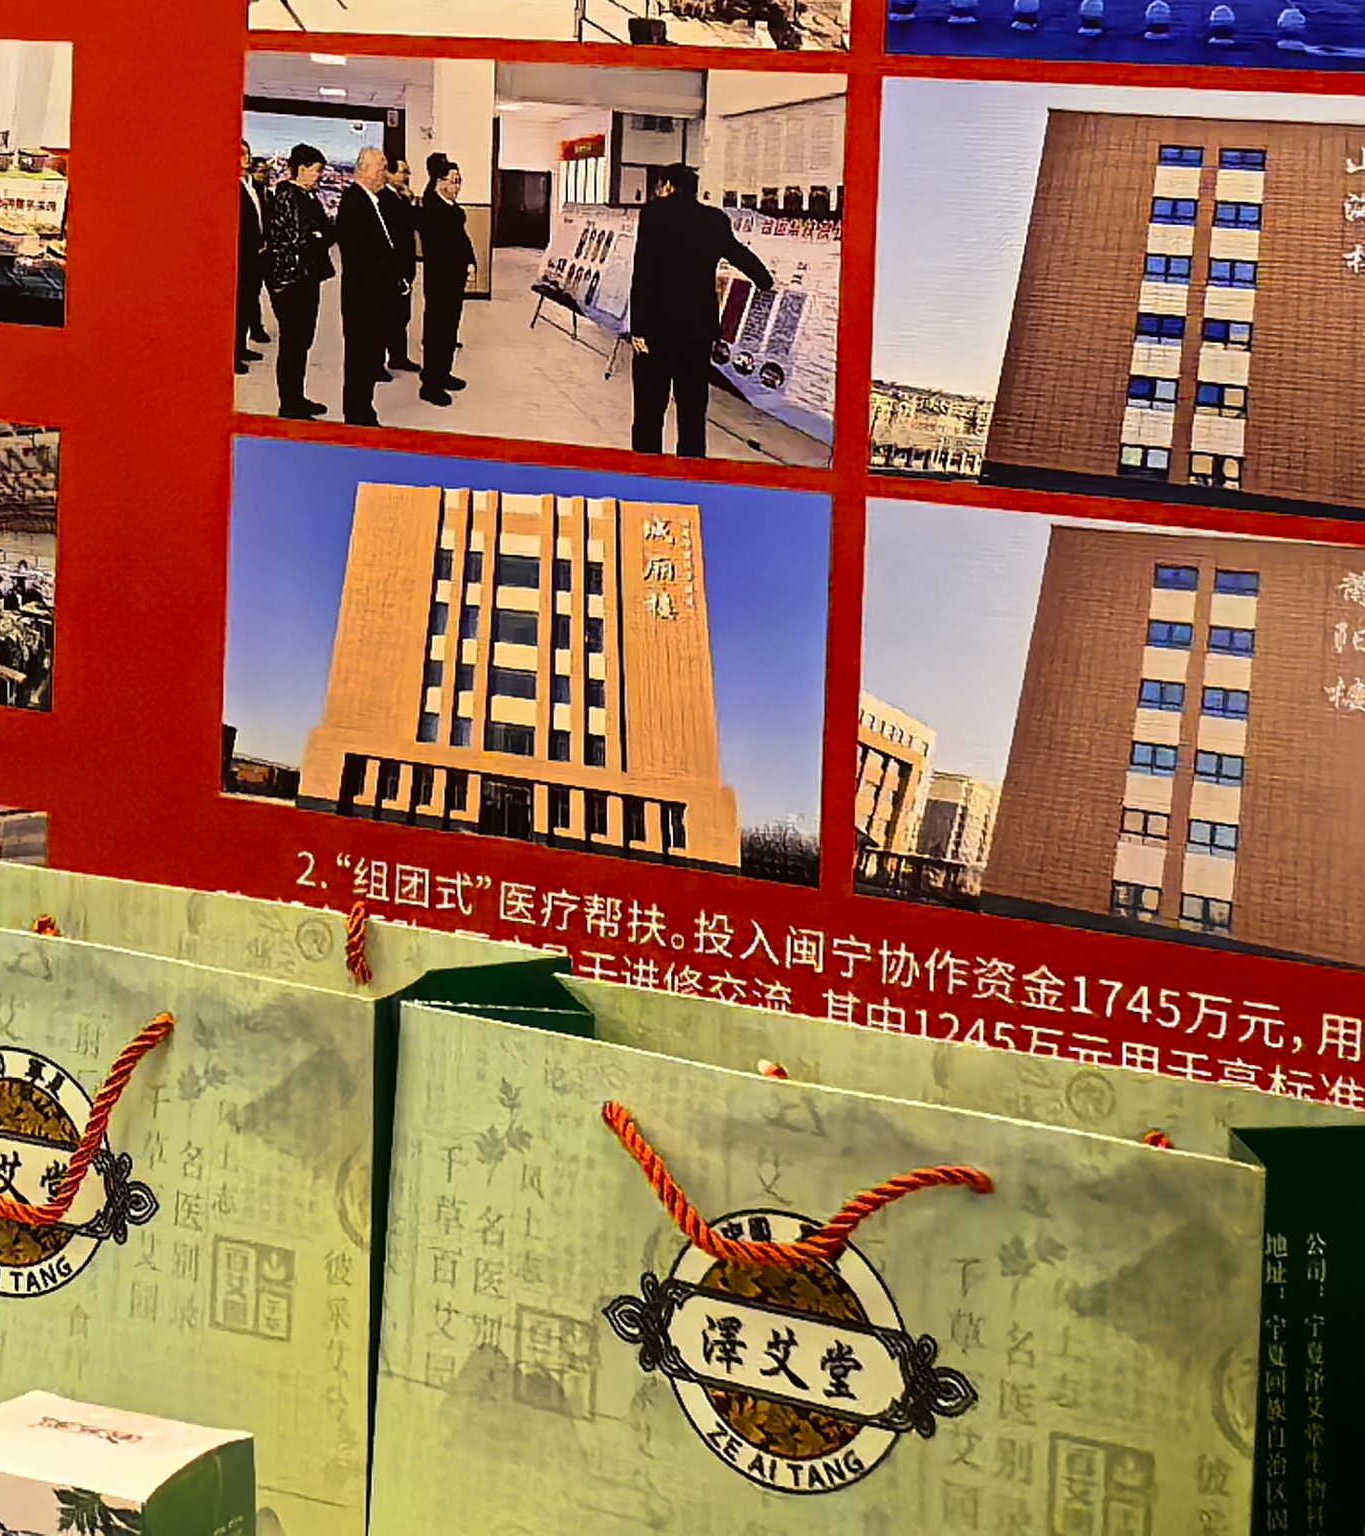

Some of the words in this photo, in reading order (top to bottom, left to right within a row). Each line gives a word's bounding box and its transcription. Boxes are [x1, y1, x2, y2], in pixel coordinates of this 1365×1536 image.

[10, 1257, 74, 1293] TANG
[701, 1314, 864, 1402] 澤艾堂
[706, 1422, 743, 1464] ZE
[748, 1454, 778, 1482] AI
[786, 1450, 866, 1489] TANG
